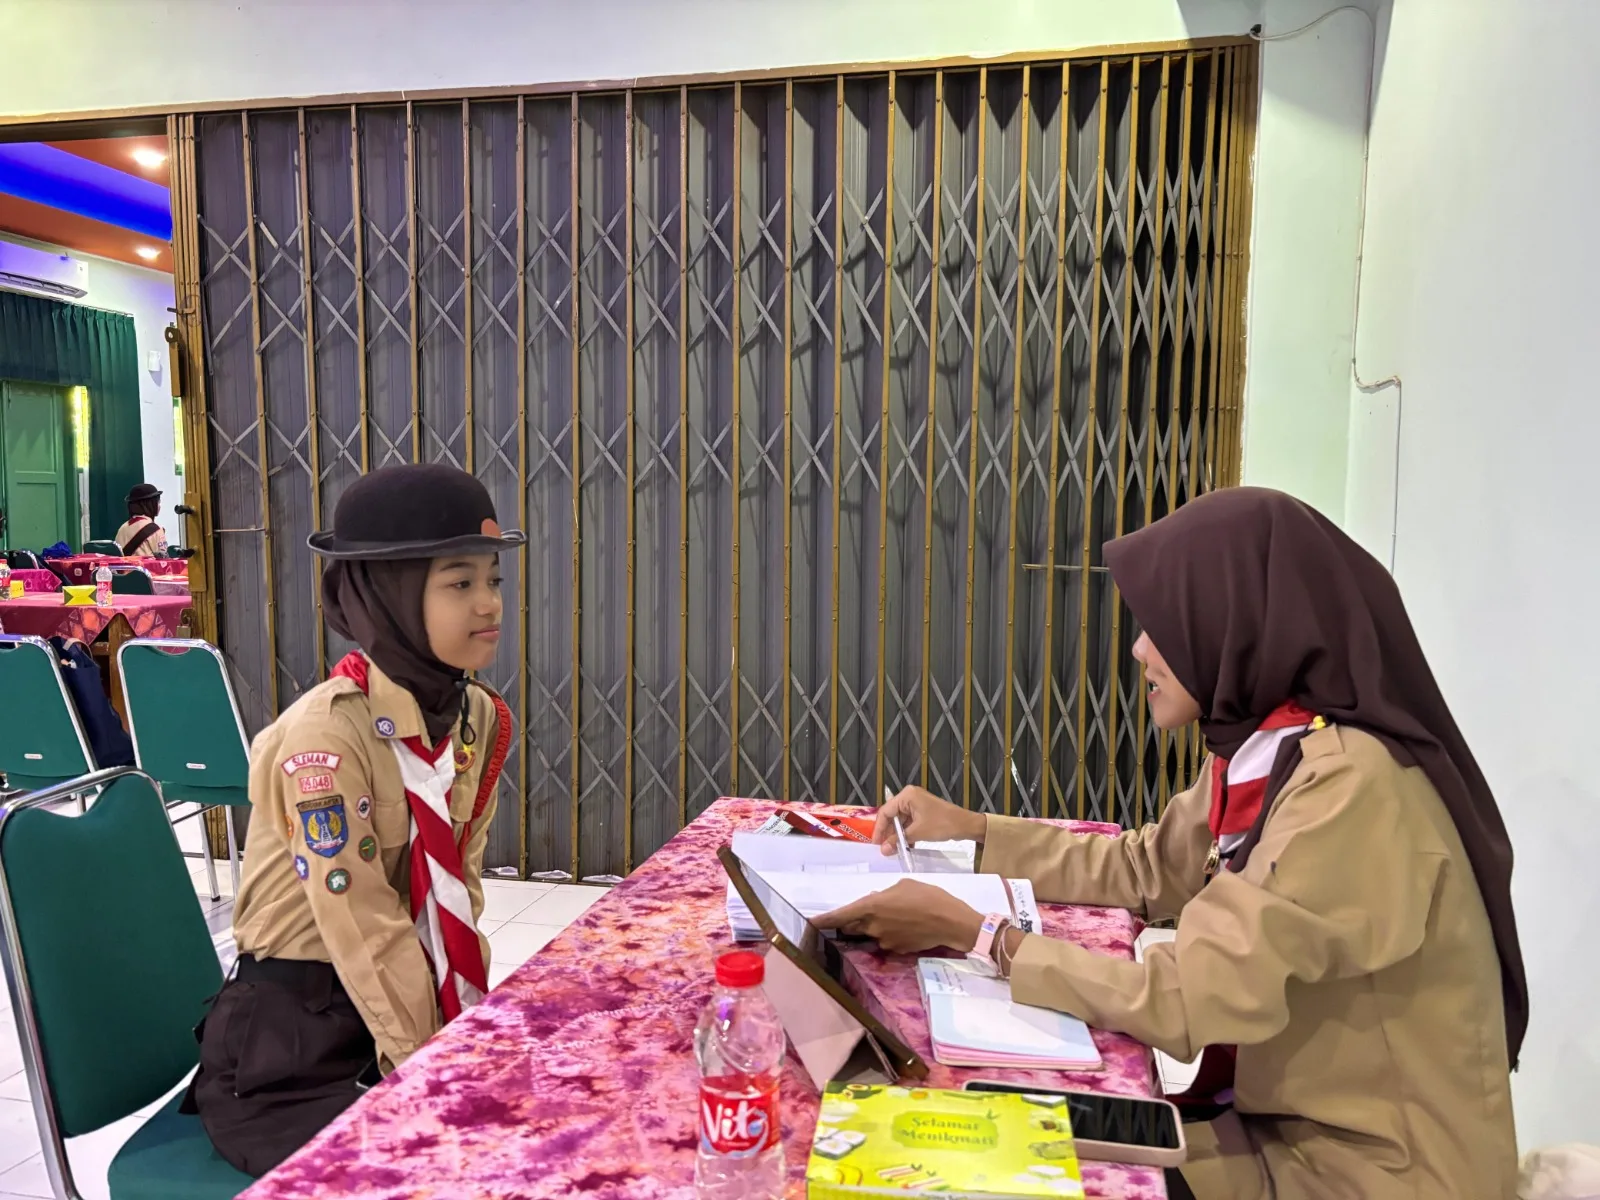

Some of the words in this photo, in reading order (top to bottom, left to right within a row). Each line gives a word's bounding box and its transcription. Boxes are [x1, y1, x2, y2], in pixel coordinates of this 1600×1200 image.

[292, 754, 329, 767] SLEMAN
[911, 1117, 979, 1130] Selamat
[898, 1128, 994, 1145] Menikmati
